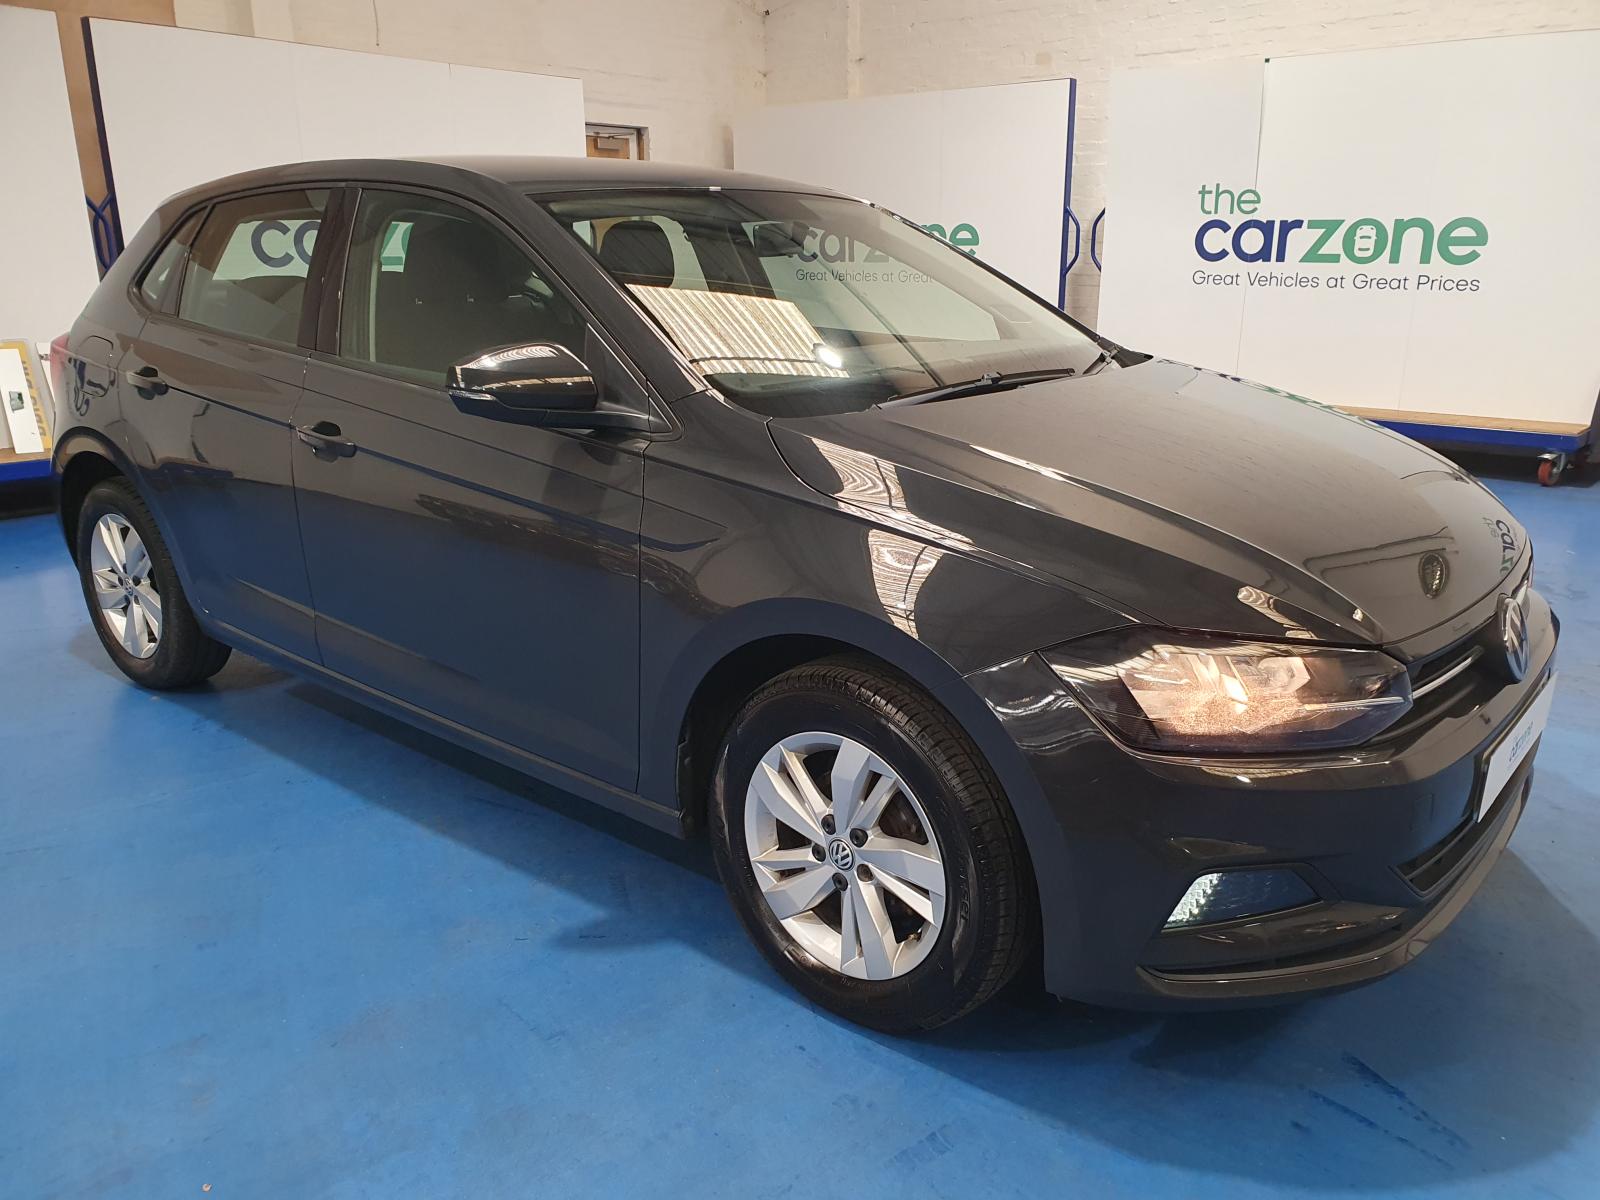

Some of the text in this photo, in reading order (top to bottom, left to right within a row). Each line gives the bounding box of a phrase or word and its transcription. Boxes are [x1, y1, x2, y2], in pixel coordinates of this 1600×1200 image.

[1198, 183, 1262, 215] the
[1194, 217, 1489, 266] carzone
[795, 269, 828, 282] Great
[831, 269, 878, 283] Vehicles
[881, 272, 895, 284] at
[1192, 270, 1482, 292] Great Vehicles at Great Prices
